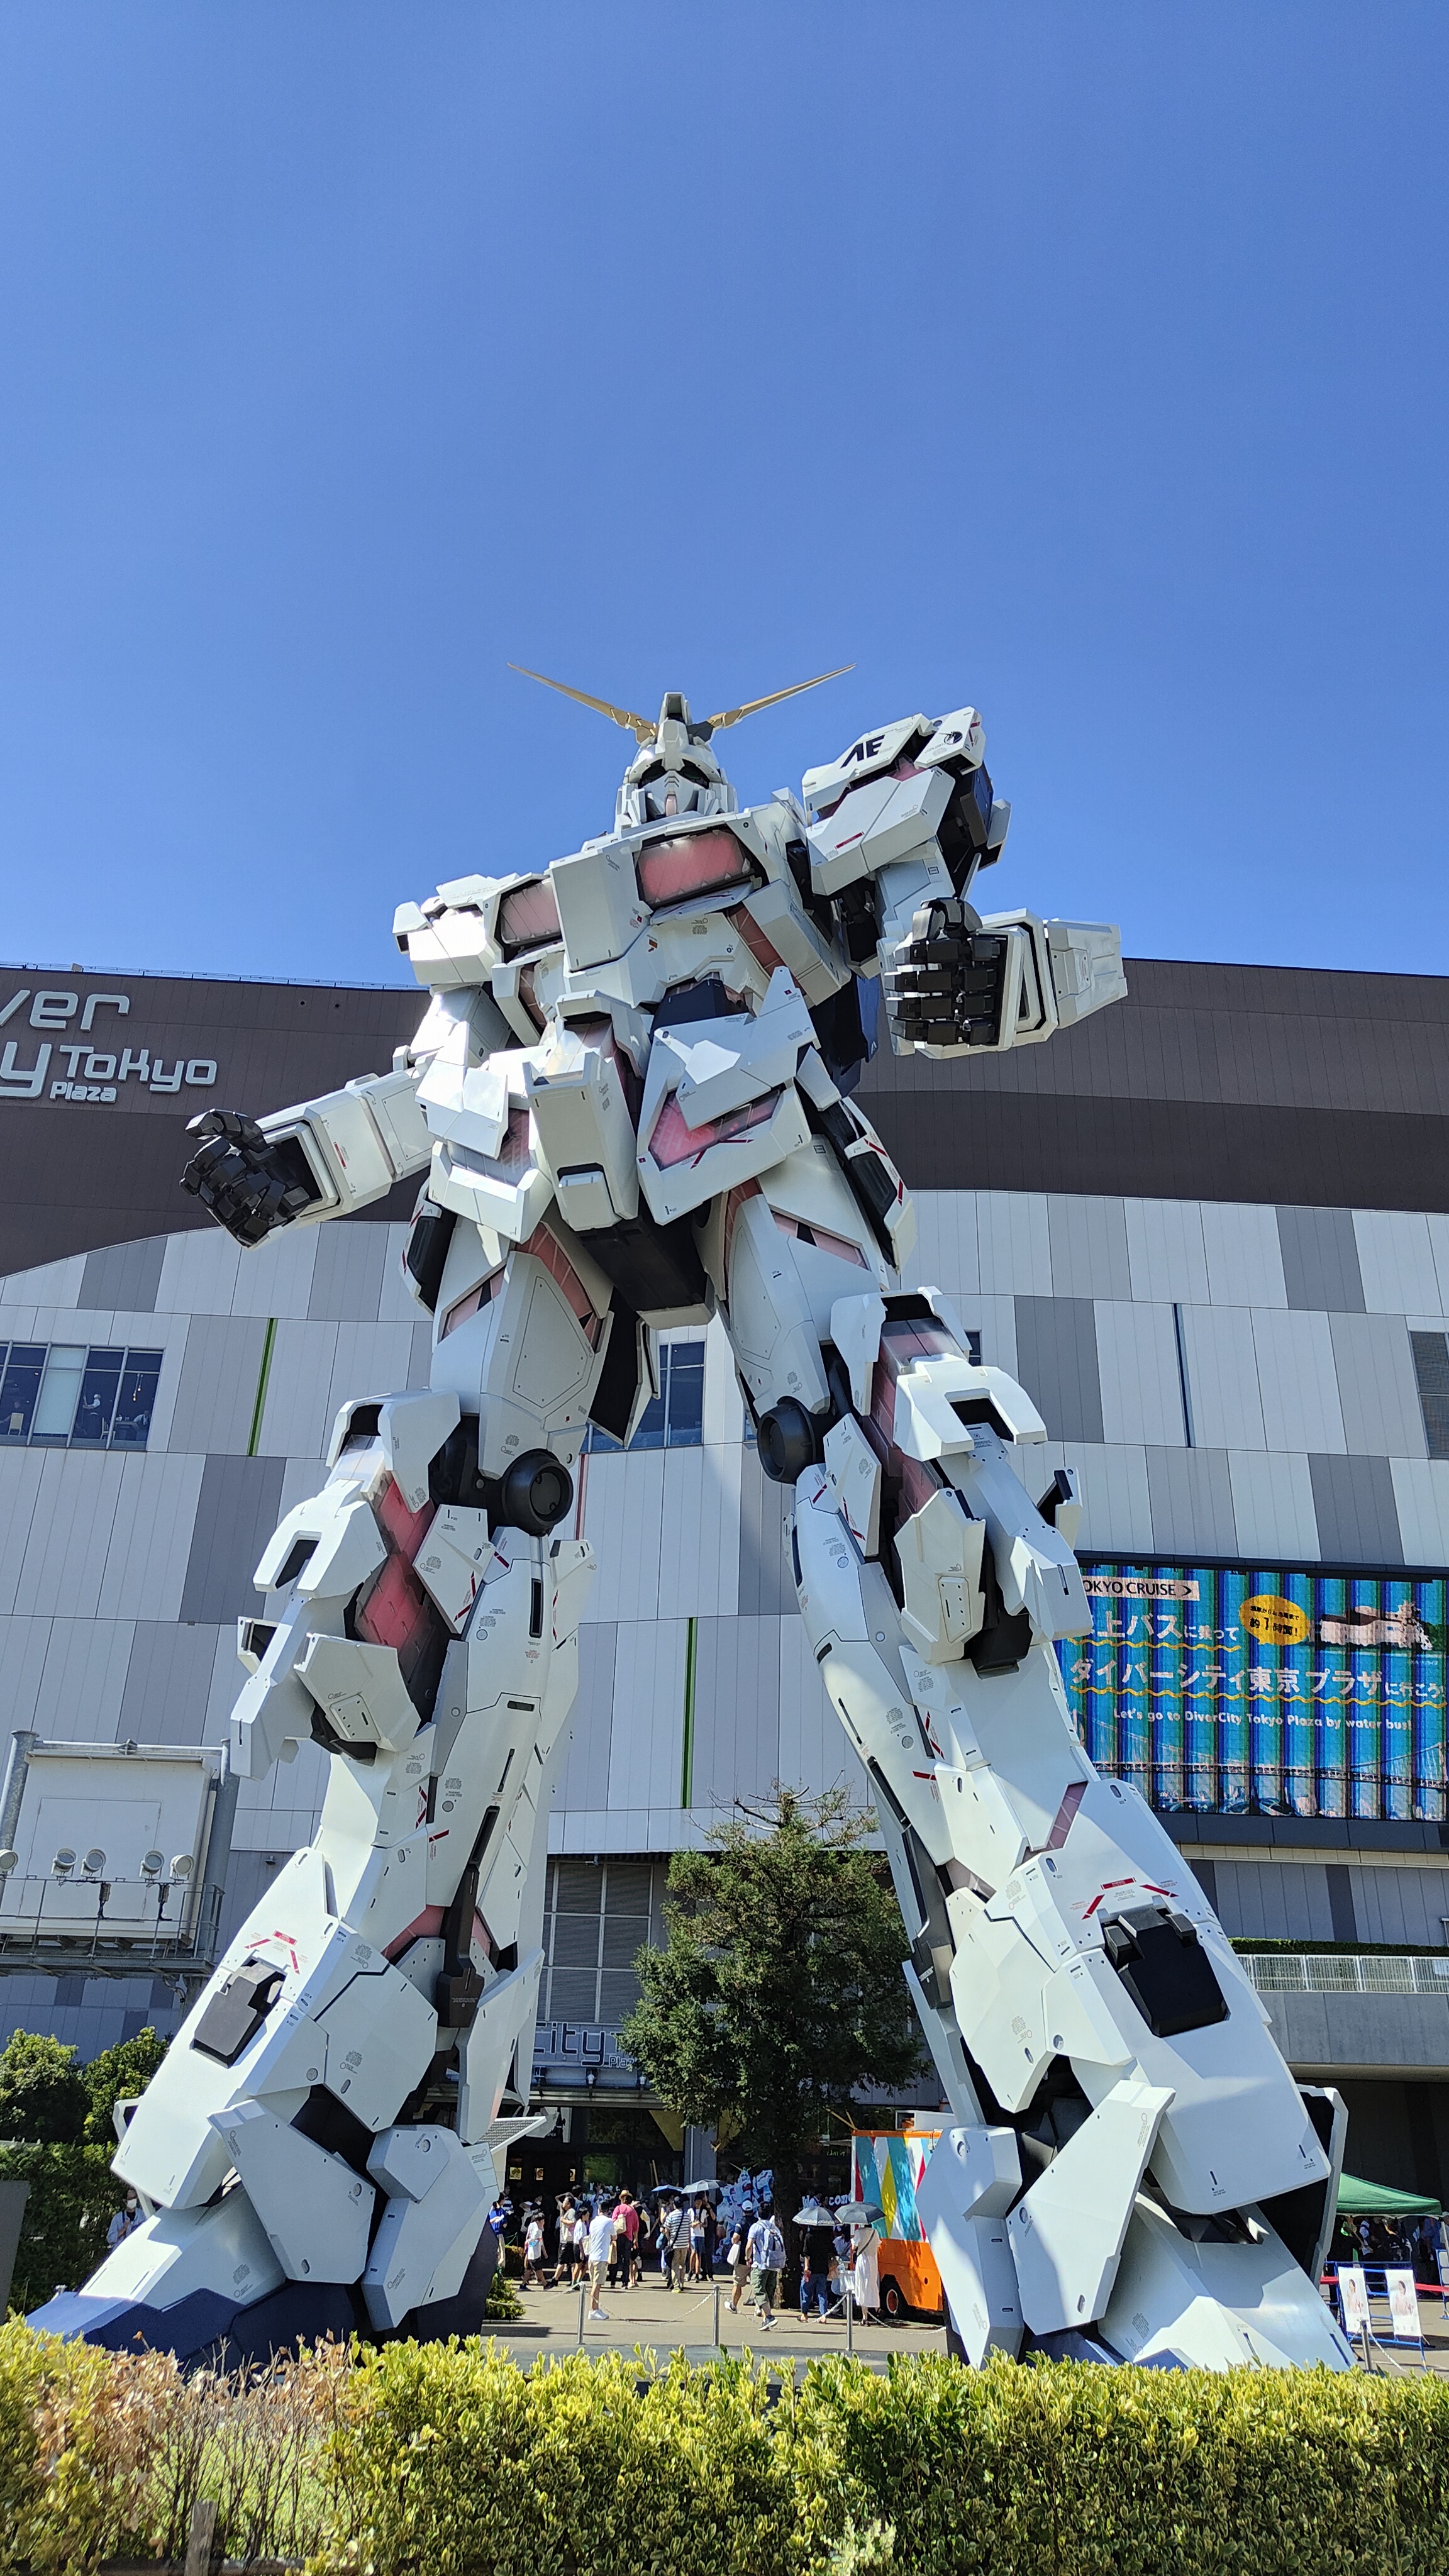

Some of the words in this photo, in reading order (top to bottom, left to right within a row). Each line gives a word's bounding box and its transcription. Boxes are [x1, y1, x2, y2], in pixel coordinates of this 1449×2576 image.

[59, 1045, 217, 1093] Tokyo
[50, 1081, 118, 1103] Plaza
[1082, 1579, 1123, 1594] OKYO
[1126, 1582, 1176, 1596] CRUISE
[1091, 1611, 1239, 1641] 上バスに乗って
[1114, 1708, 1143, 1720] Let's
[1147, 1711, 1163, 1722] go
[1167, 1711, 1180, 1721] to
[1185, 1711, 1241, 1725] DiverCity
[1246, 1713, 1283, 1727] Tokyo
[1287, 1715, 1322, 1726] Plaza
[1326, 1716, 1341, 1729] by
[1345, 1719, 1382, 1729] water
[608, 2055, 635, 2068] Plaz
